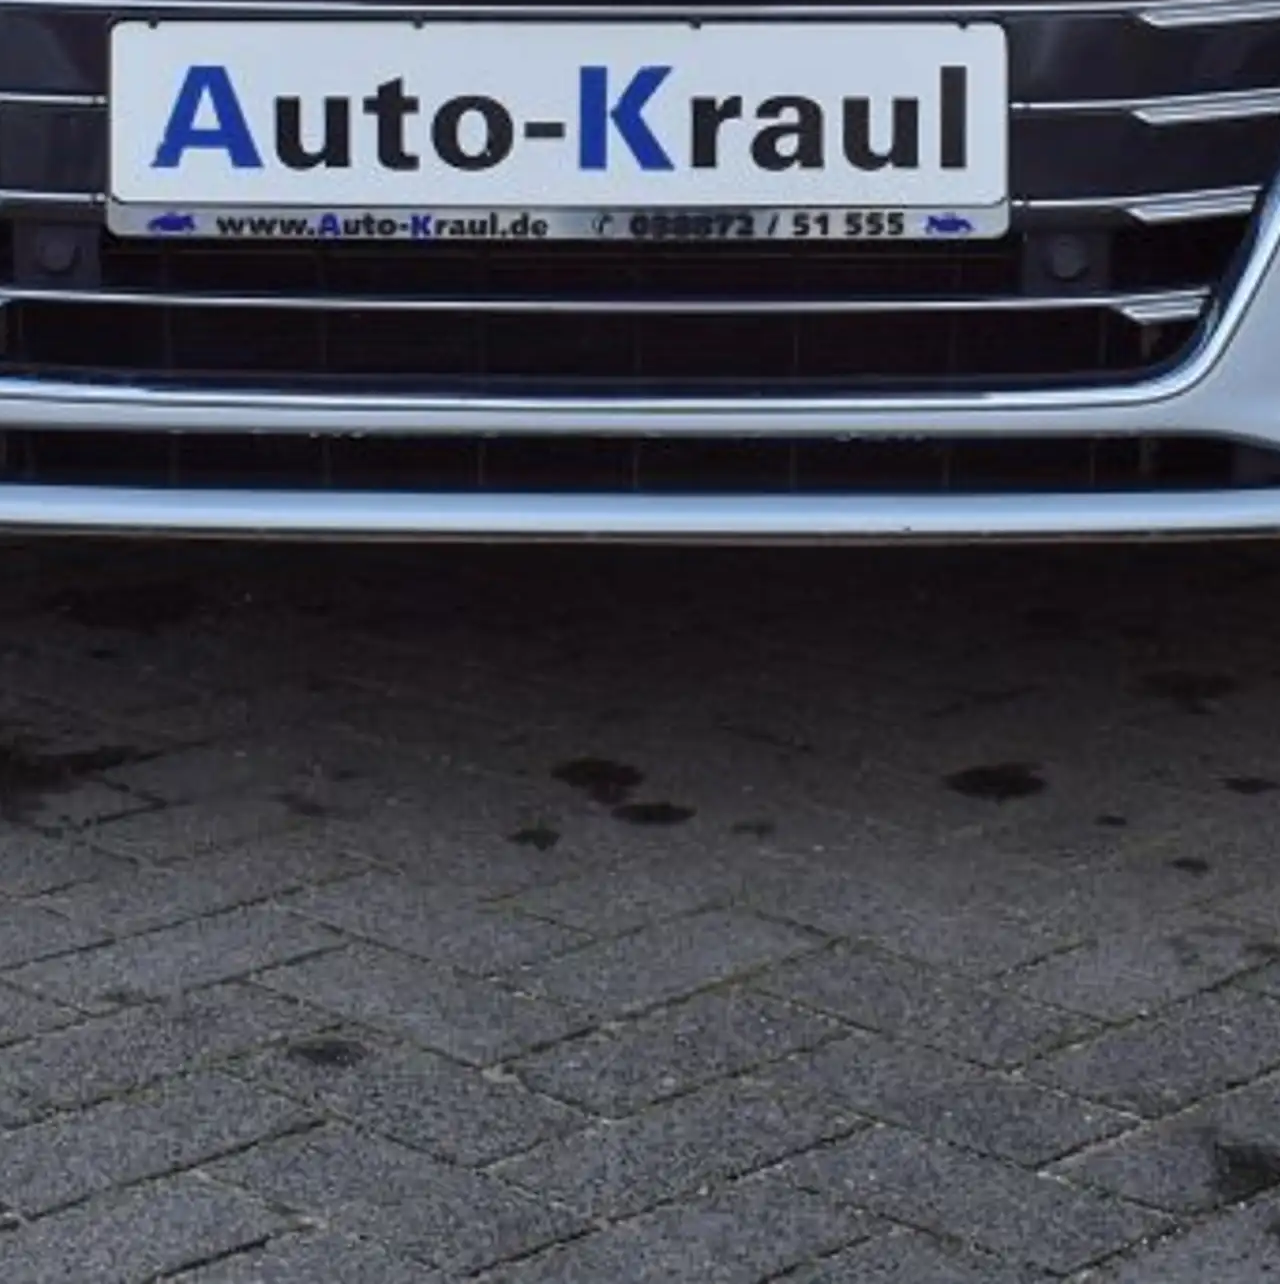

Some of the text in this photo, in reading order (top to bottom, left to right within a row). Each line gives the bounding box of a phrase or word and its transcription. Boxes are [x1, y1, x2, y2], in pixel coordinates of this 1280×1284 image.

[150, 64, 968, 171] Auto-Kraul
[216, 213, 549, 237] www.Auto-Kraul.de
[792, 213, 829, 236] 51
[844, 212, 905, 236] 555
